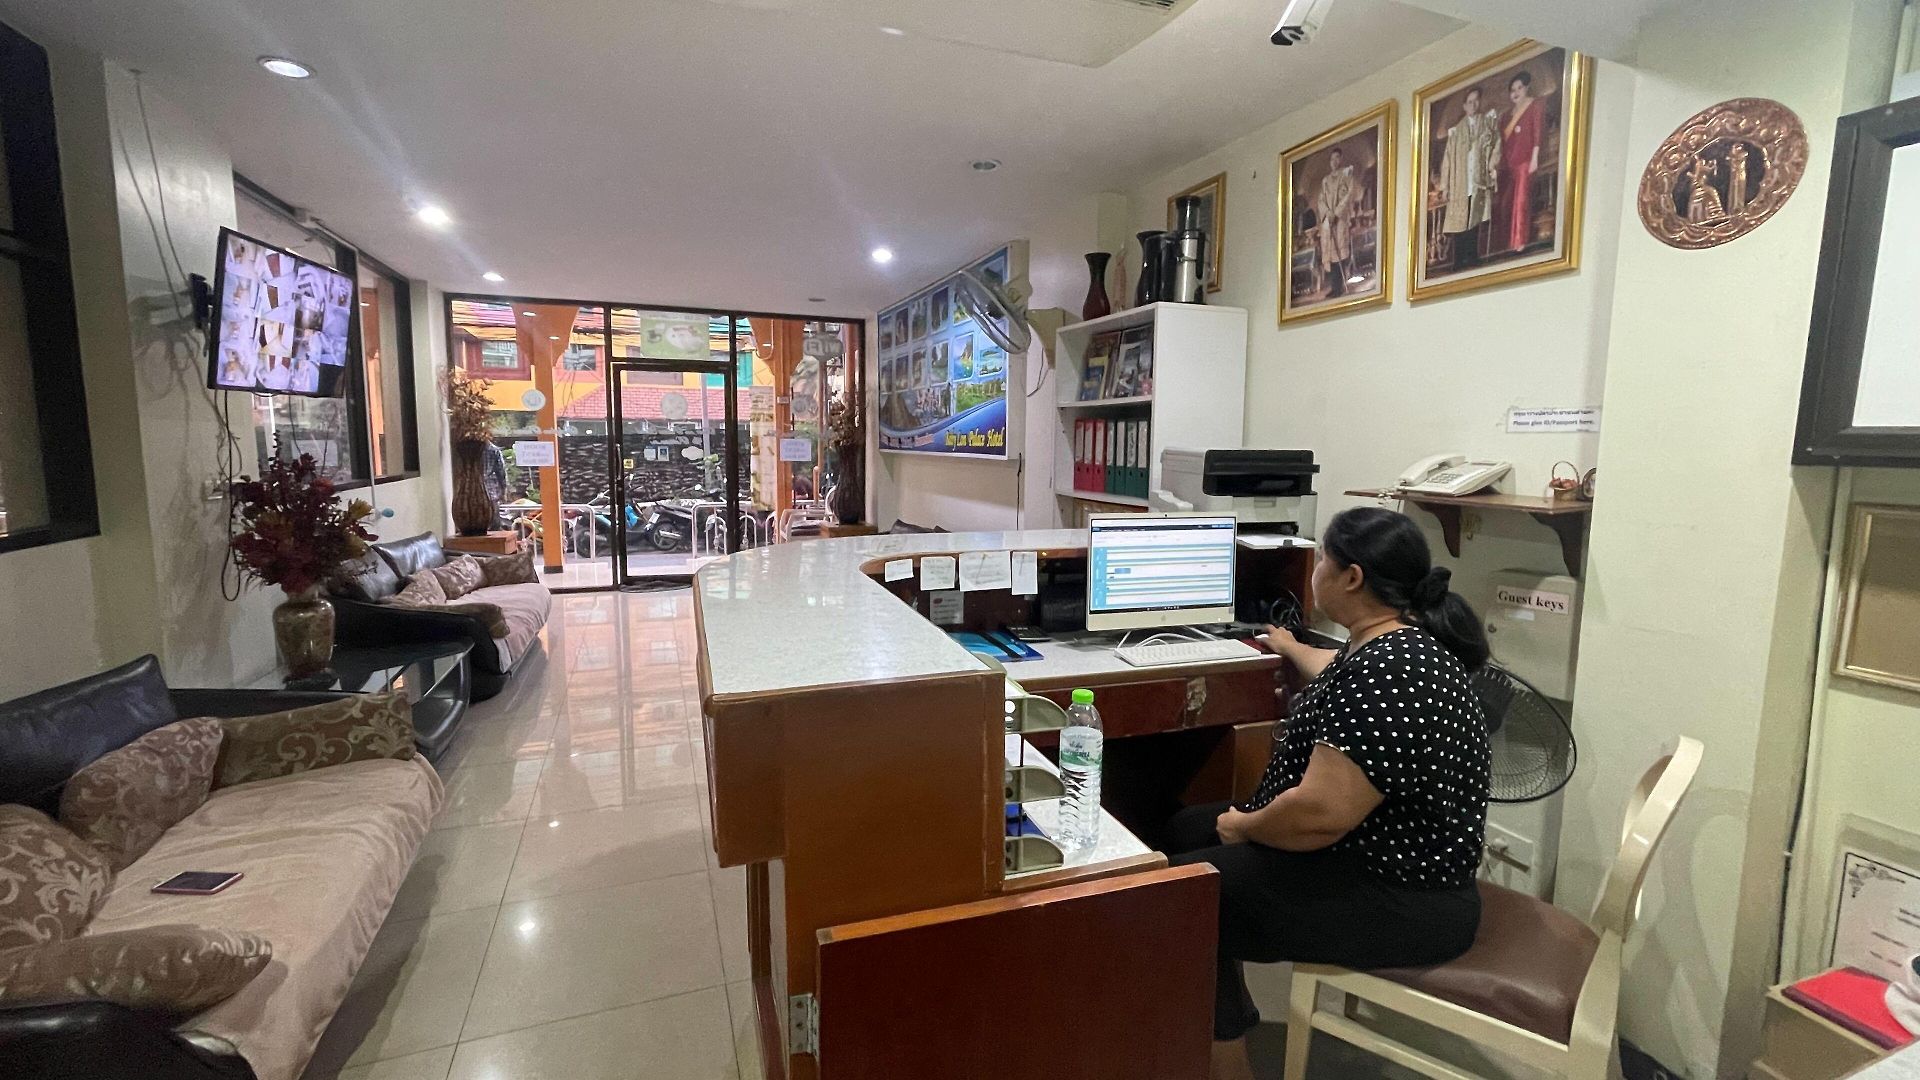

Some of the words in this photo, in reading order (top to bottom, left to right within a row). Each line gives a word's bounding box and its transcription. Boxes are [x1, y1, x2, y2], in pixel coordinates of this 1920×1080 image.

[986, 427, 1004, 447] Hotel
[1498, 590, 1532, 605] Guest
[1536, 596, 1564, 612] keys
